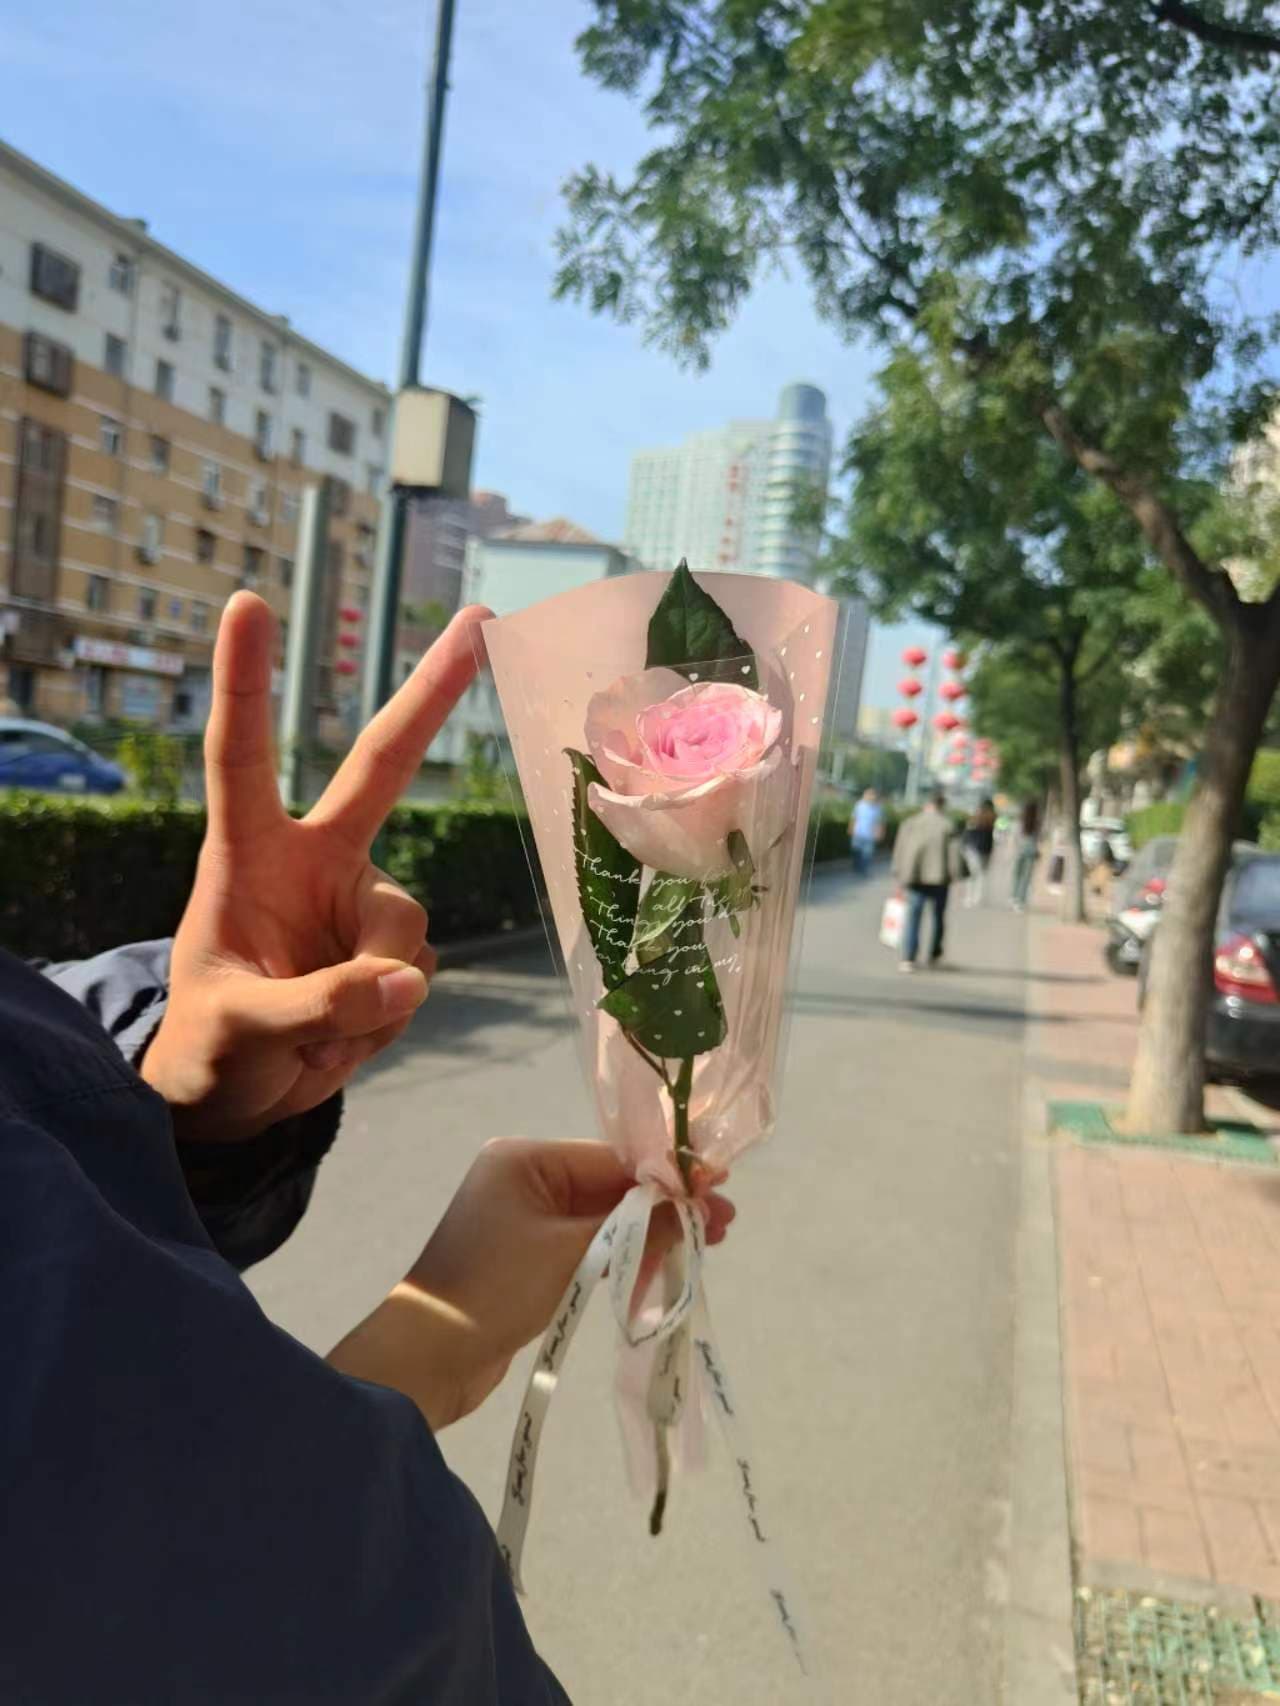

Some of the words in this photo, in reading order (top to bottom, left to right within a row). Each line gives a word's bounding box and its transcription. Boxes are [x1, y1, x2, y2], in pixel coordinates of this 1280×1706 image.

[575, 848, 641, 884] Thank
[652, 878, 690, 898] you
[652, 895, 686, 912] all
[672, 917, 712, 938] you
[590, 920, 663, 952] Thak
[667, 943, 709, 964] you
[621, 959, 680, 986] ing
